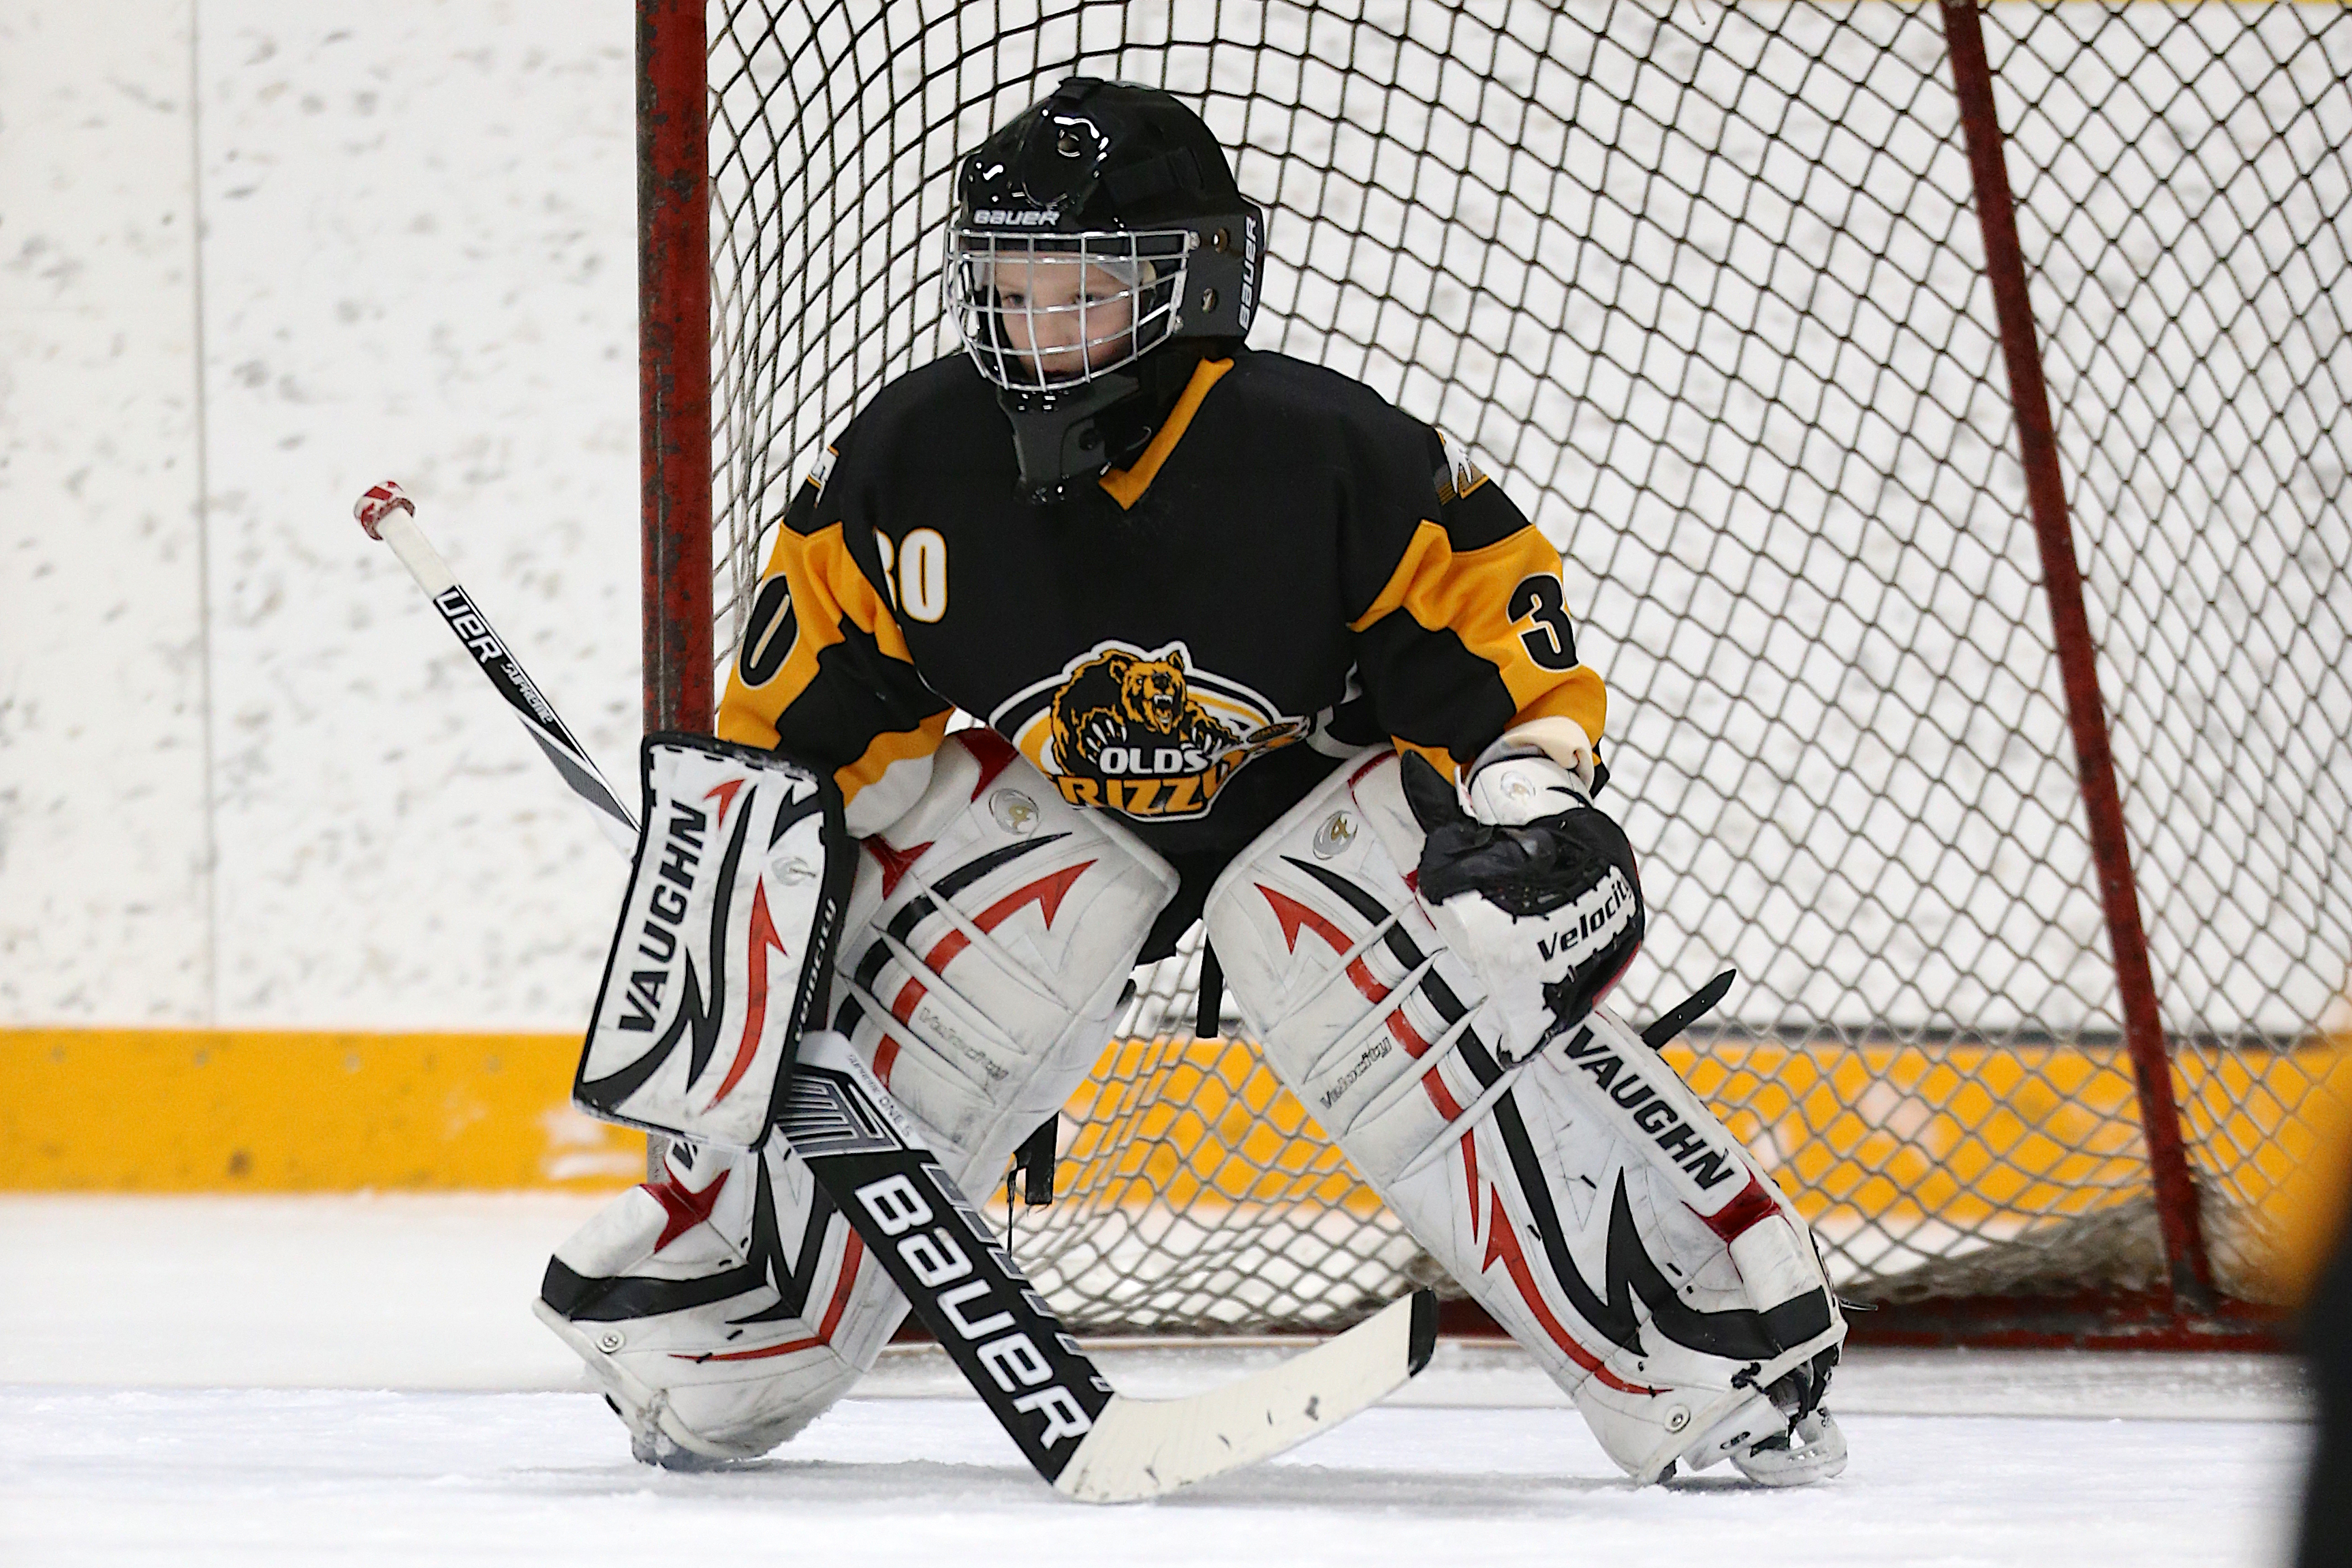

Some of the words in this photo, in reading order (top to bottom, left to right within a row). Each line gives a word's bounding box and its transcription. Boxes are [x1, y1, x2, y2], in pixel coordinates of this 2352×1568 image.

[973, 209, 1060, 226] BAUER
[1238, 215, 1257, 332] BAUER
[1099, 747, 1209, 774] OLDS
[618, 799, 708, 1034] VAUGHN
[1565, 1024, 1736, 1191] VAUGHN
[854, 1173, 1092, 1450] BAUER
